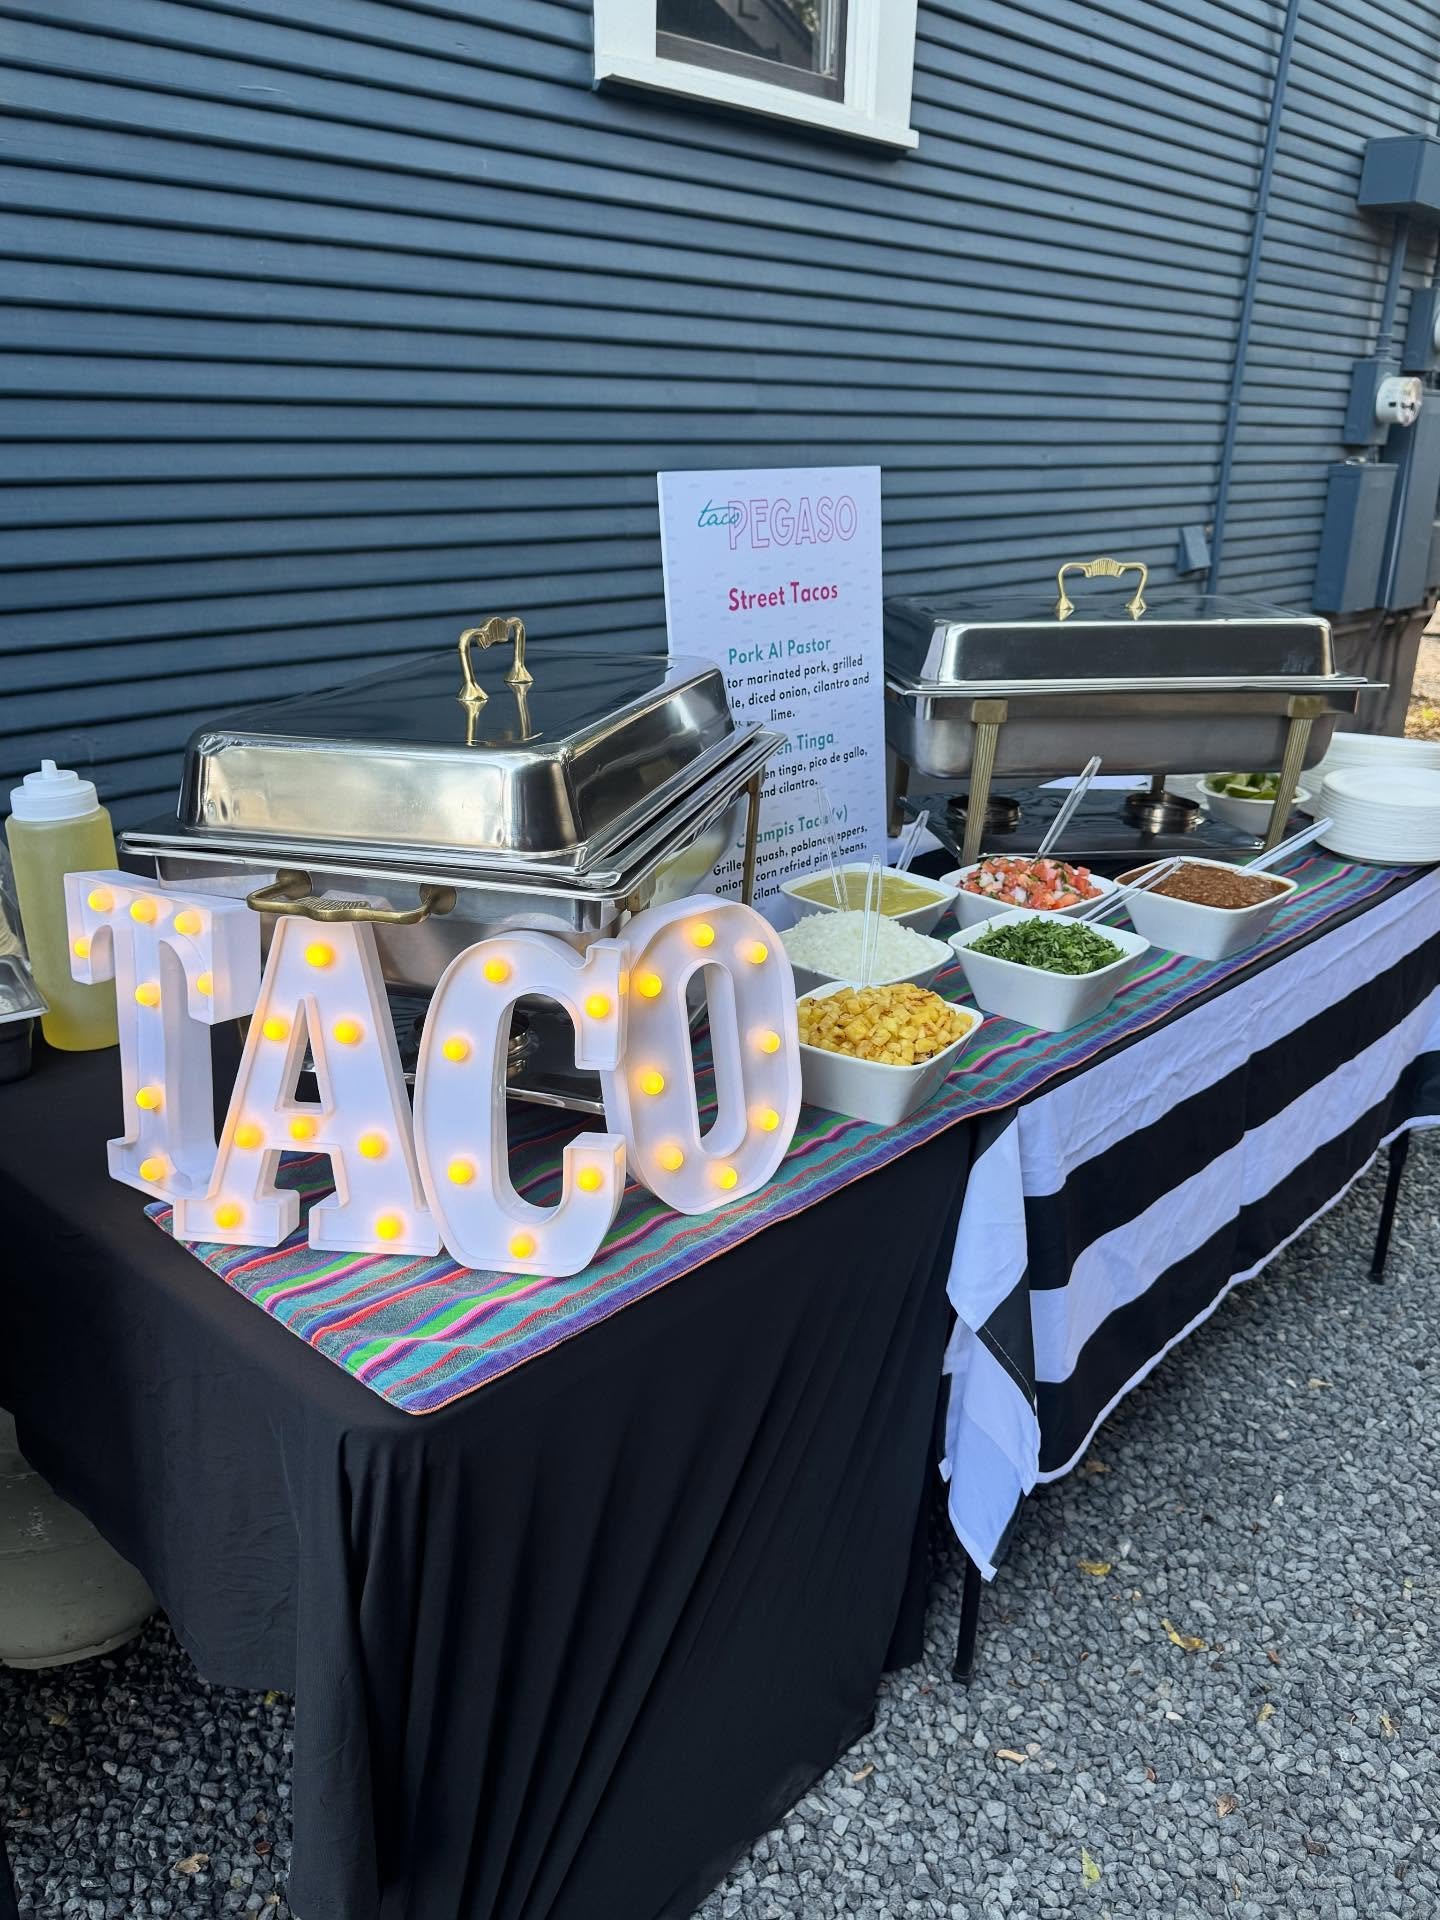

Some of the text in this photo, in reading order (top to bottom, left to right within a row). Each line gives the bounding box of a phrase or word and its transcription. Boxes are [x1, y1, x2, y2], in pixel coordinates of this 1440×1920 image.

[698, 495, 858, 550] taco PEGASO
[728, 581, 838, 611] Street Tacos
[728, 637, 832, 665] Pork Al Pastor
[727, 677, 744, 689] tor
[747, 667, 801, 686] marinated
[832, 654, 863, 674] grilled
[731, 671, 870, 709] le, diced onion, cilantro and
[770, 708, 796, 722] lime.
[797, 732, 834, 751] Tinga
[778, 763, 806, 776] tinga,
[809, 756, 828, 772] pico
[830, 751, 841, 764] de
[843, 745, 868, 763] gallo,
[760, 778, 818, 799] and cilantro.
[736, 819, 795, 849] ampis
[798, 816, 829, 832] Tac
[713, 859, 745, 876] Grille
[755, 846, 788, 866] quash,
[755, 869, 777, 882] corn
[780, 855, 812, 876] refried
[814, 849, 838, 867] pin
[753, 884, 780, 902] cilant
[63, 868, 802, 1278] TACO
